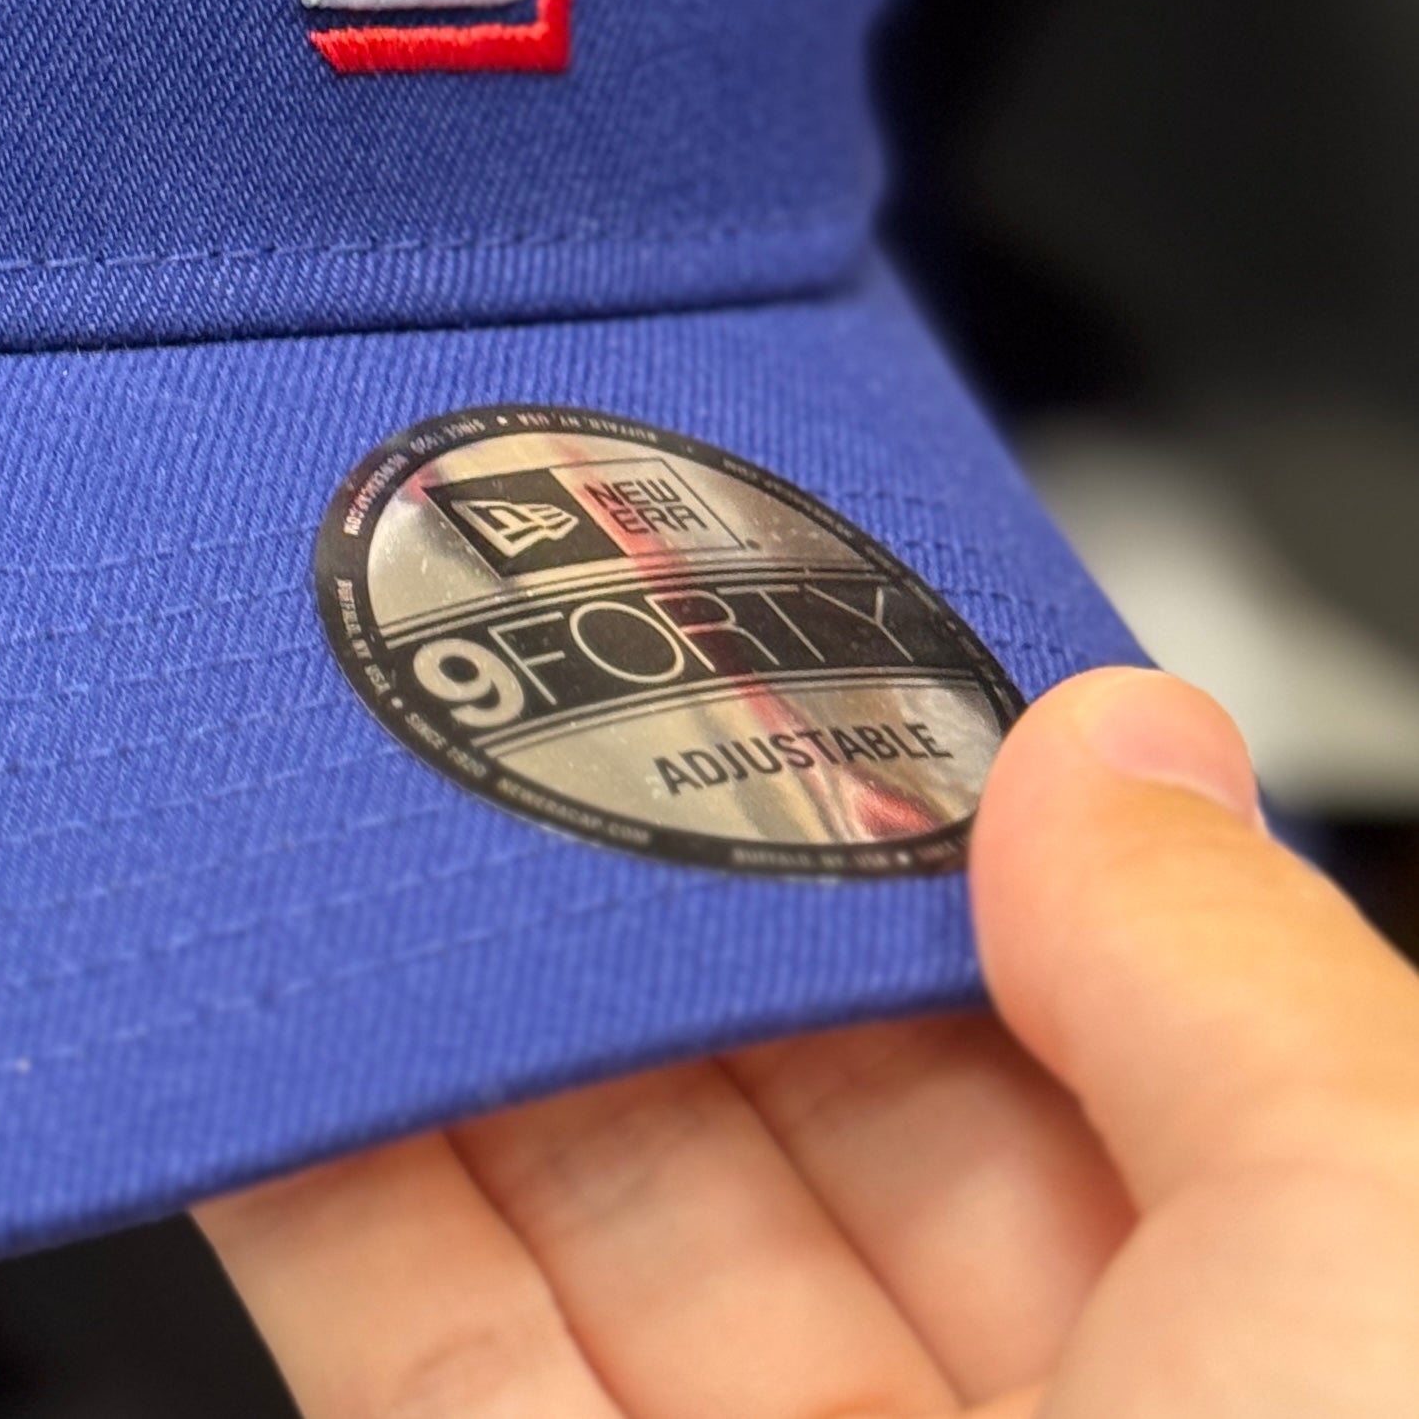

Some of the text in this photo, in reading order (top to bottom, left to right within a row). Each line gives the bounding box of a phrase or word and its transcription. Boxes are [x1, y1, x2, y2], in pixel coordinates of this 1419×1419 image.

[583, 477, 681, 508] NEW
[610, 505, 709, 534] ERA
[412, 585, 915, 728] 9FORTY
[652, 721, 954, 796] ADJUSTABLE
